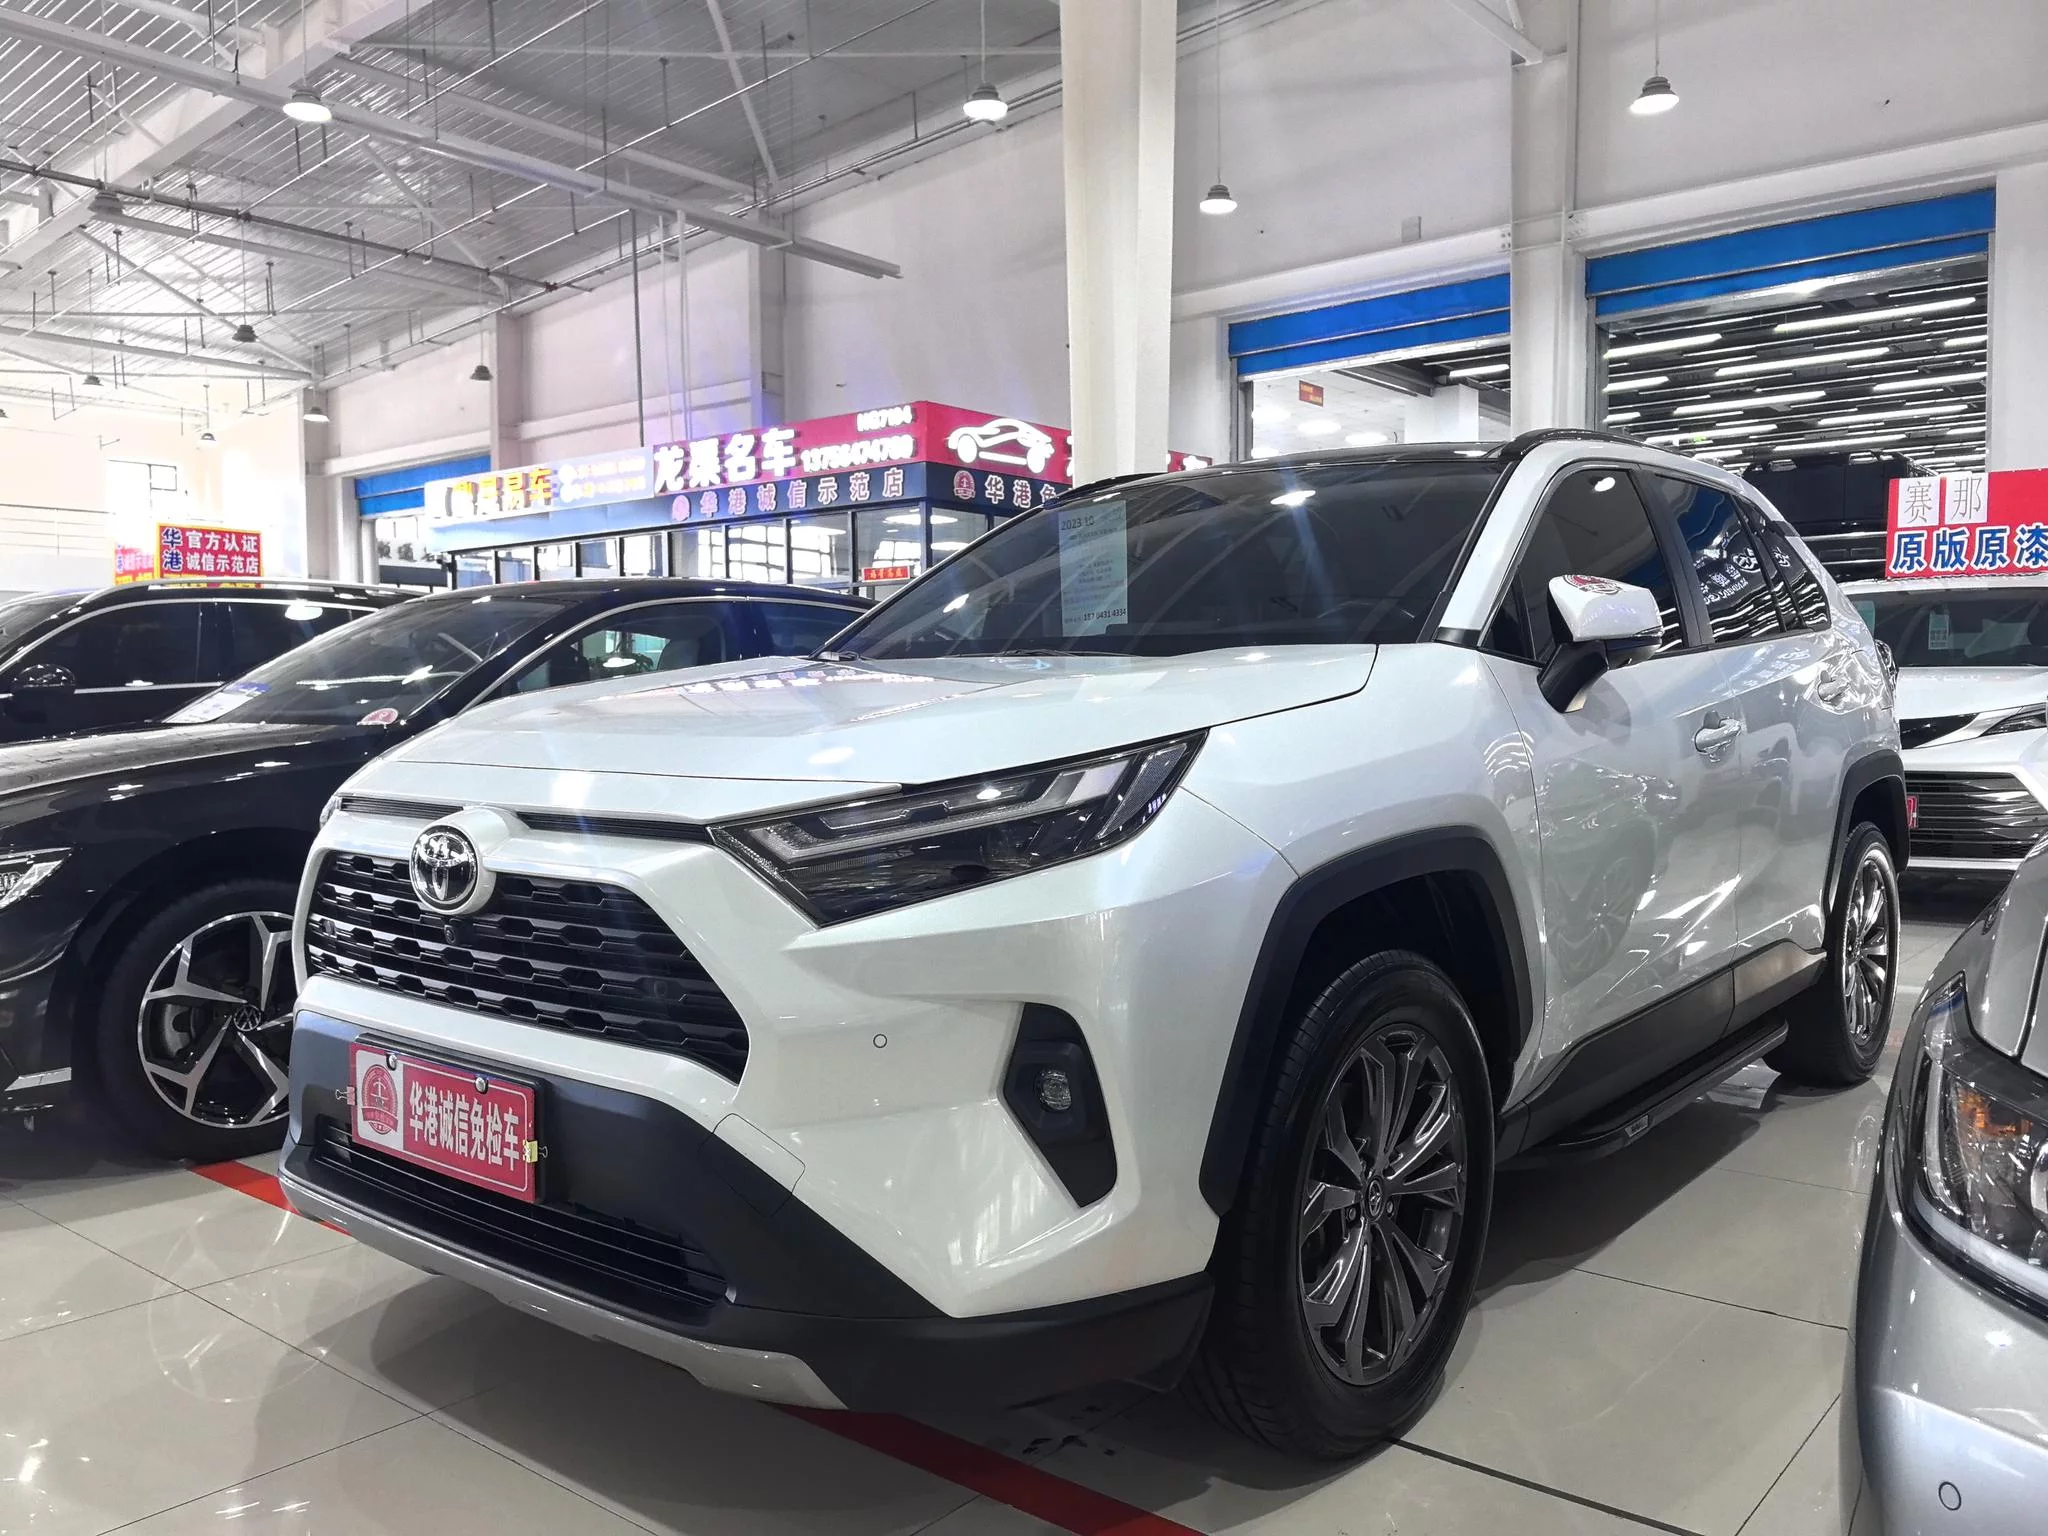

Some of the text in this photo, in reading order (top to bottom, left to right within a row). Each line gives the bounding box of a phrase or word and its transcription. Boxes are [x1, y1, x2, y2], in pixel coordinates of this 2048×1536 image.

[700, 468, 904, 518] 华港诚信示范店
[1904, 477, 1983, 523] 赛那
[185, 530, 258, 553] 官方认证
[1061, 517, 1082, 530] 2023
[162, 527, 182, 572] 华港
[185, 552, 259, 575] 诚信示范店
[1889, 522, 2048, 573] 原版原漆
[409, 1081, 520, 1171] 华港诚信免检车
